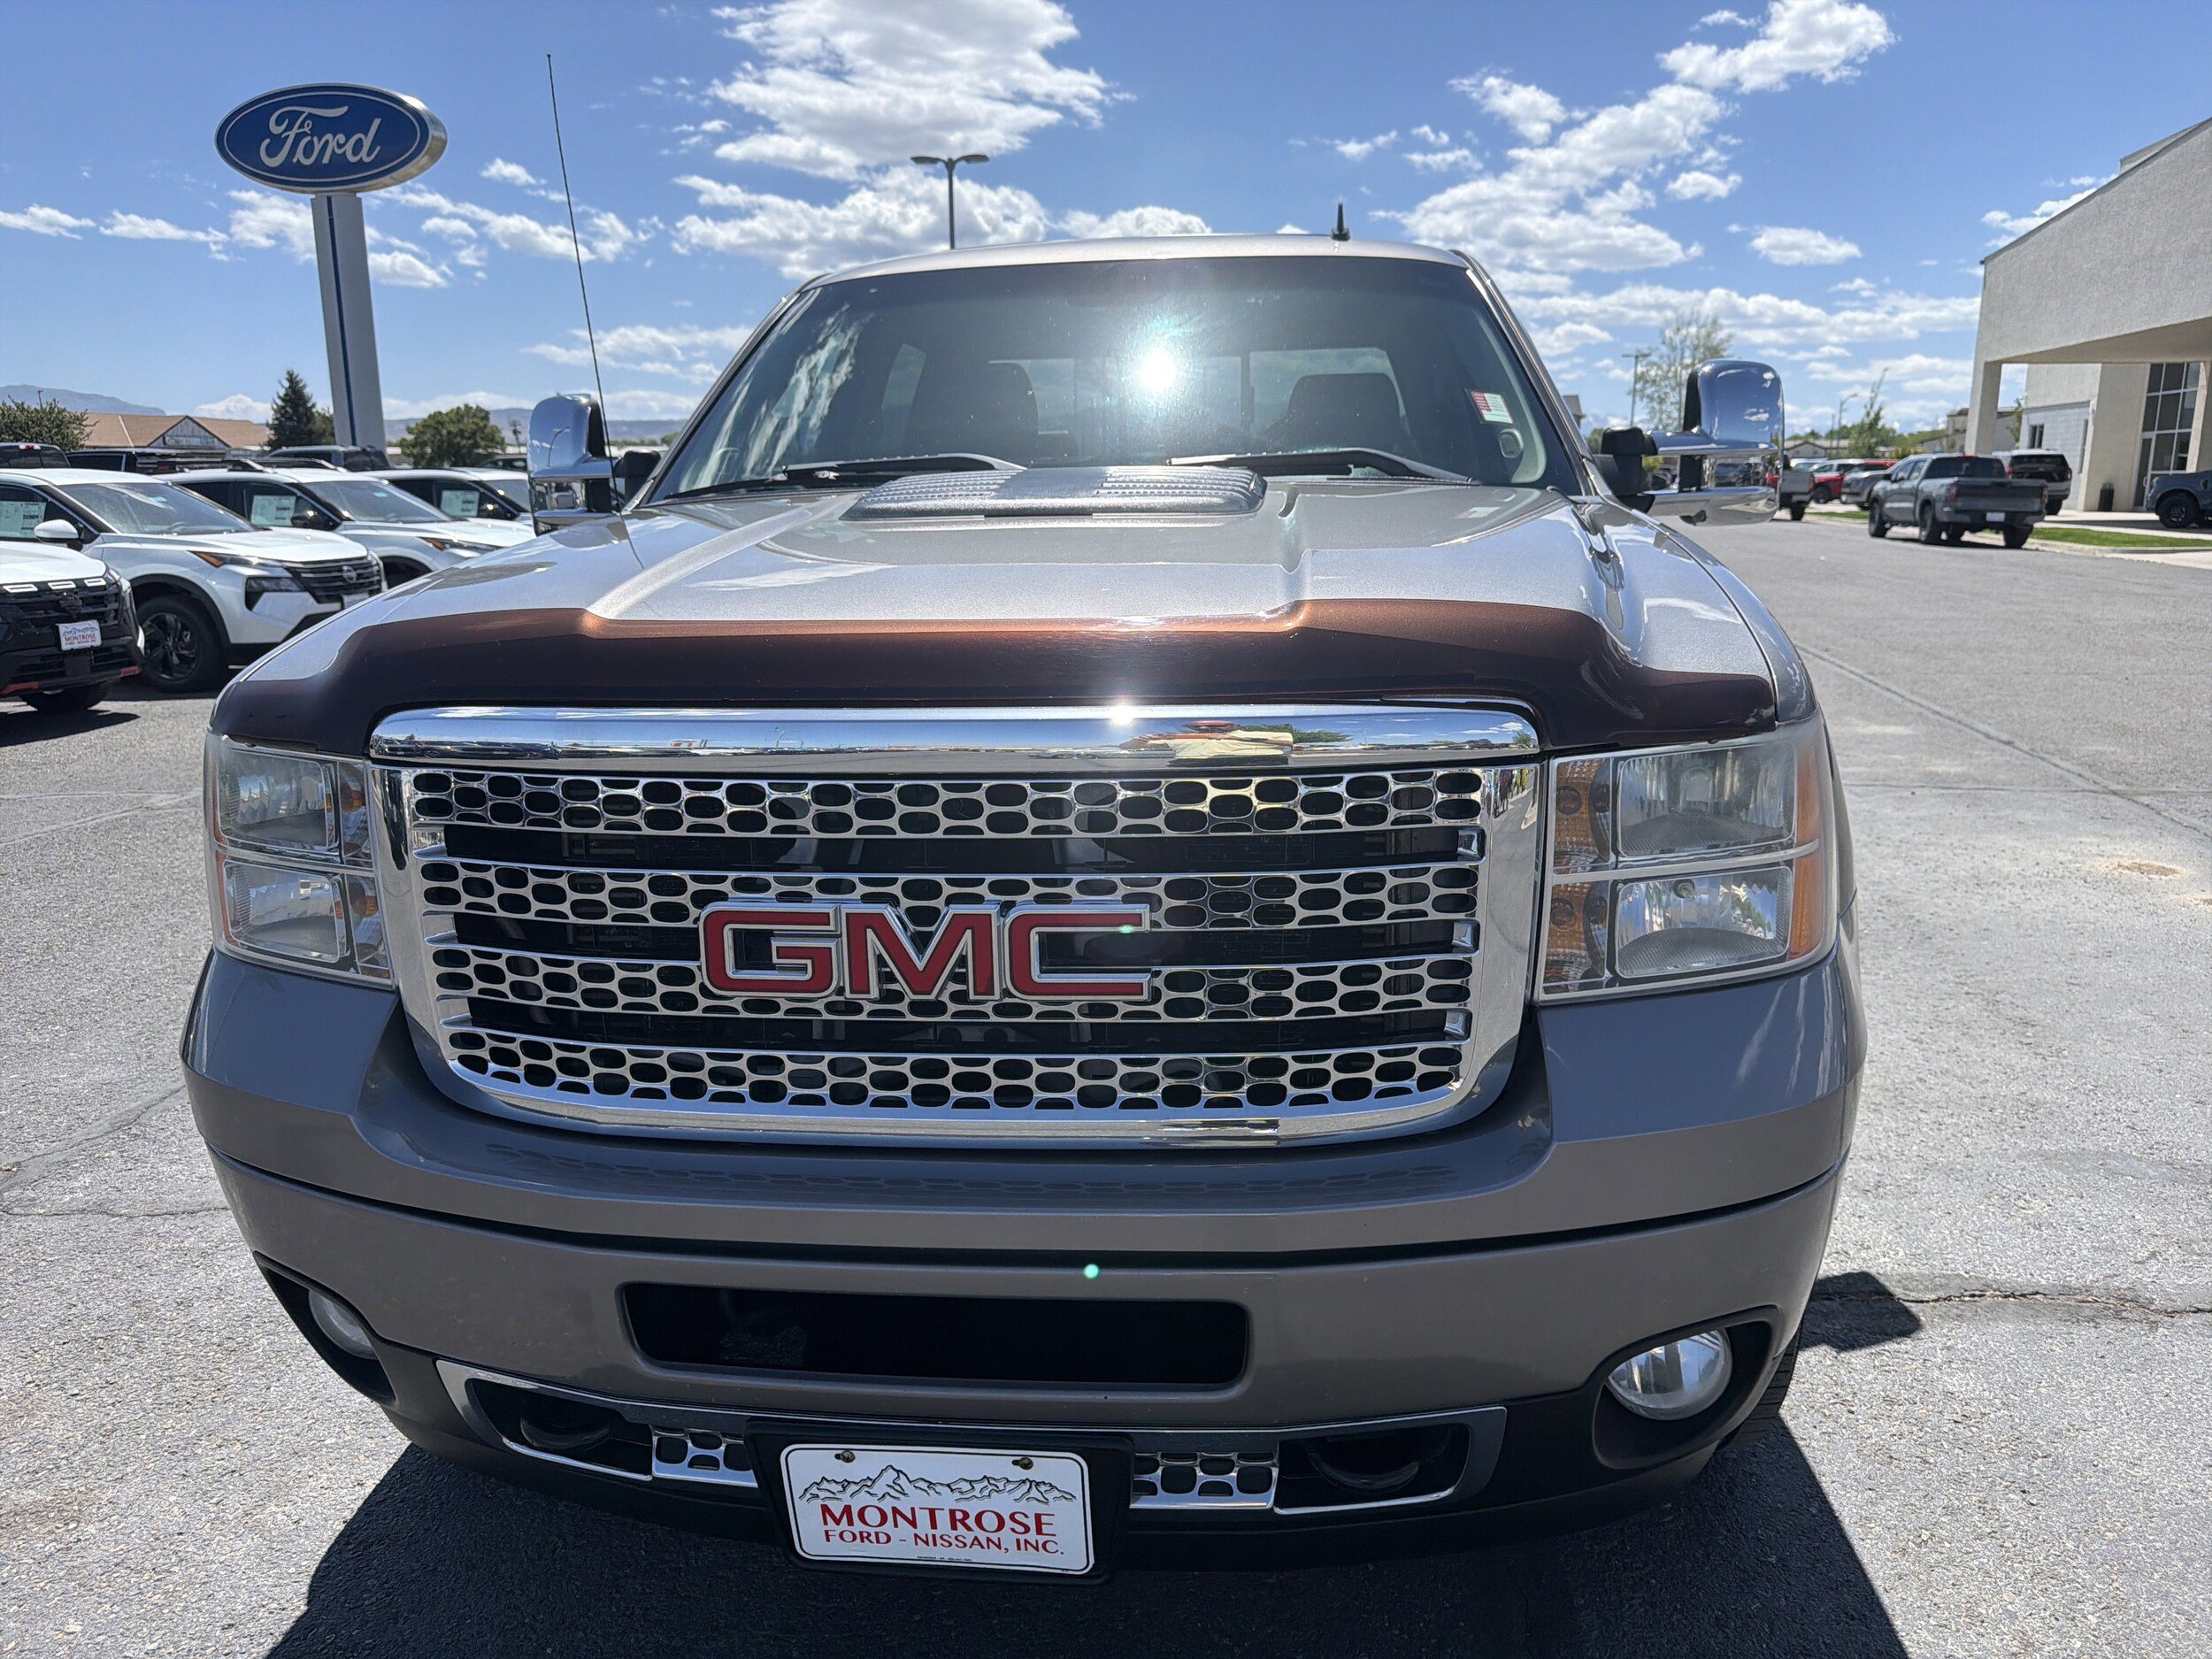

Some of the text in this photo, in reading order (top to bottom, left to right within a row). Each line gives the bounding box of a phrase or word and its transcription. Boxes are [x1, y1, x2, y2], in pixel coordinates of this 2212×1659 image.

[259, 105, 381, 168] Ford
[699, 901, 1152, 1002] GMC
[820, 1503, 1057, 1537] MONTROSE
[824, 1529, 892, 1545] FORD
[913, 1532, 1010, 1554] NISSAN,
[1015, 1538, 1064, 1555] INC.
